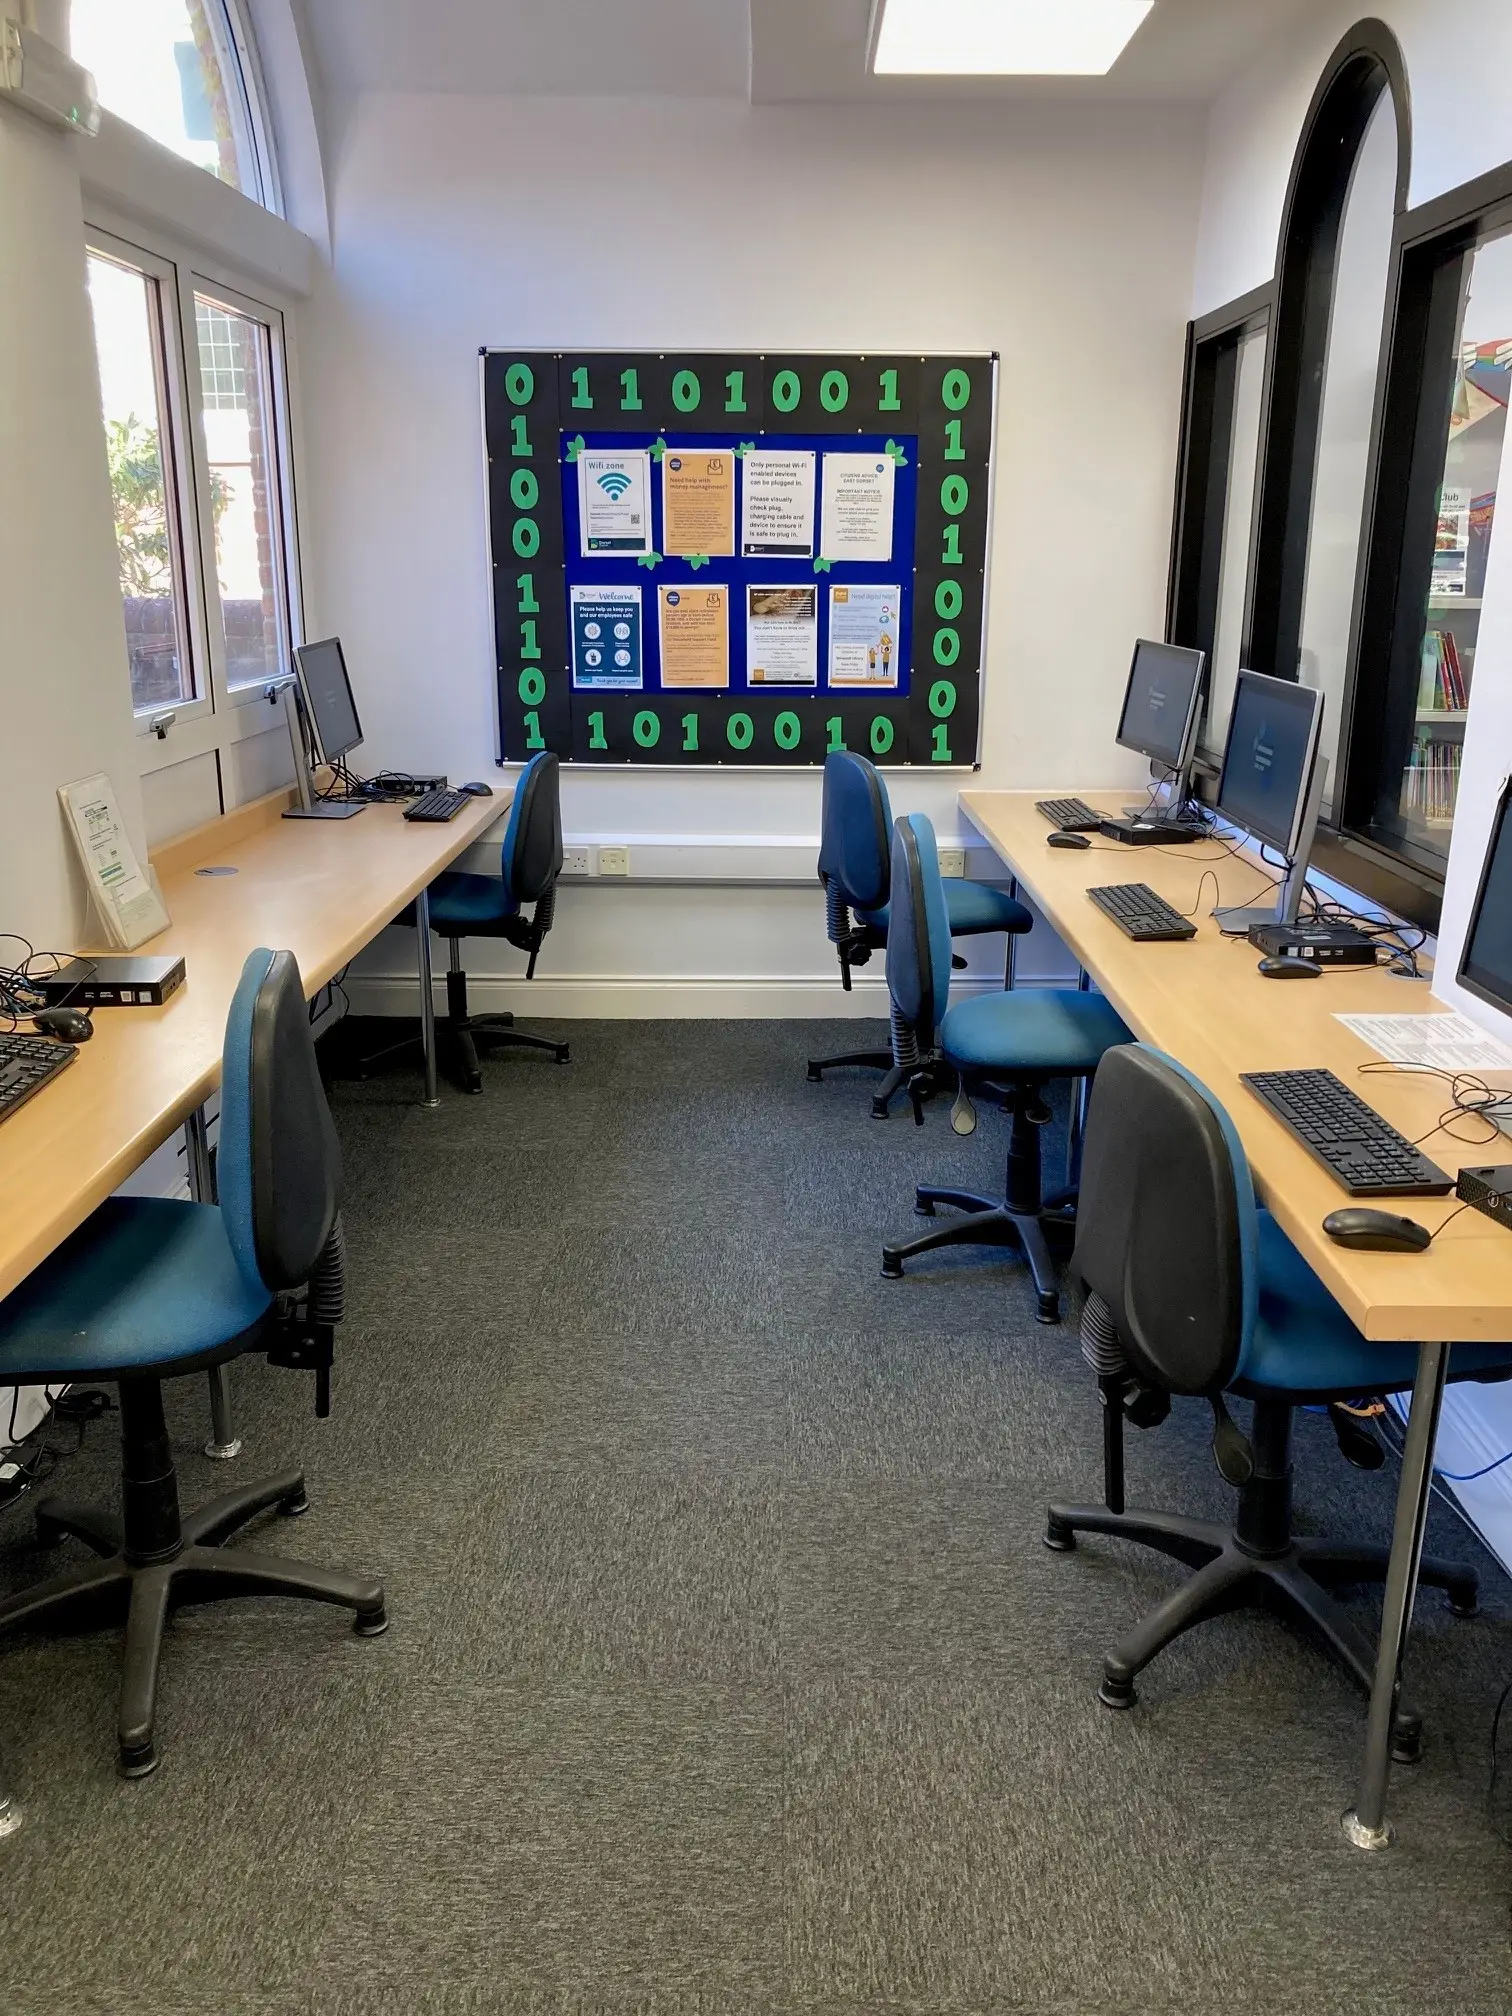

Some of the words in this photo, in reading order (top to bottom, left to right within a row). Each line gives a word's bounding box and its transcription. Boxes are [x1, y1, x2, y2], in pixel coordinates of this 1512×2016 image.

[505, 363, 534, 406] 0
[571, 367, 594, 409] 1
[620, 369, 643, 410] 1
[672, 370, 701, 412] 0
[725, 371, 747, 413] 1
[772, 370, 800, 413] 0
[820, 370, 849, 413] 0
[878, 370, 901, 411] 1
[941, 369, 971, 411] 0
[511, 415, 533, 457] 1
[944, 420, 966, 460] 1
[588, 462, 604, 470] Wifi
[510, 469, 538, 510] 0
[940, 474, 969, 516] 0
[512, 517, 540, 558] 0
[943, 523, 965, 564] 1
[516, 573, 540, 613] 1
[599, 592, 634, 600] Welcome
[935, 579, 963, 620] 0
[520, 620, 542, 659] 1
[932, 628, 961, 667] 0
[518, 667, 545, 706] 0
[928, 680, 957, 718] 0
[523, 711, 546, 749] 1
[587, 711, 608, 750] 1
[632, 710, 661, 748] 0
[681, 713, 699, 751] 1
[726, 712, 754, 750] 0
[773, 711, 801, 750] 0
[826, 716, 848, 754] 1
[870, 715, 894, 755] 0
[931, 723, 952, 762] 1
